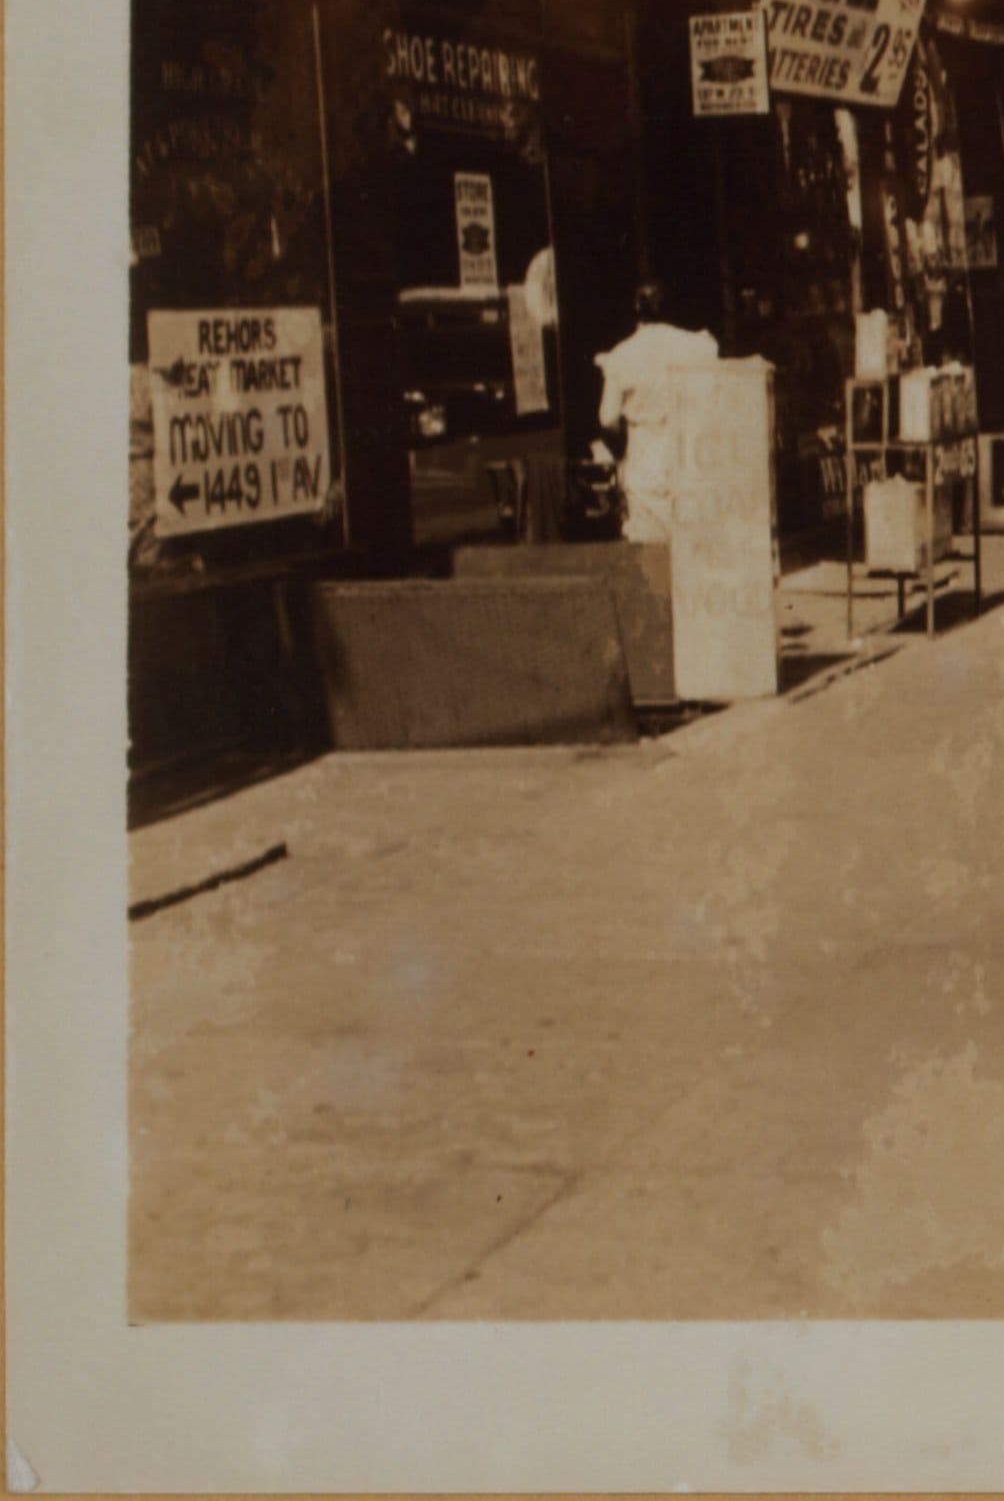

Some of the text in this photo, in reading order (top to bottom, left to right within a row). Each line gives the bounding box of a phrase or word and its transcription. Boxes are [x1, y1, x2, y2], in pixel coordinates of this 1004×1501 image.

[769, 0, 848, 47] TIRES
[383, 27, 541, 101] SHOE REPAIRING
[198, 317, 277, 355] REHORS
[175, 356, 302, 400] EAT MARKET
[169, 404, 310, 466] MOVING TO
[204, 461, 262, 517] 1449
